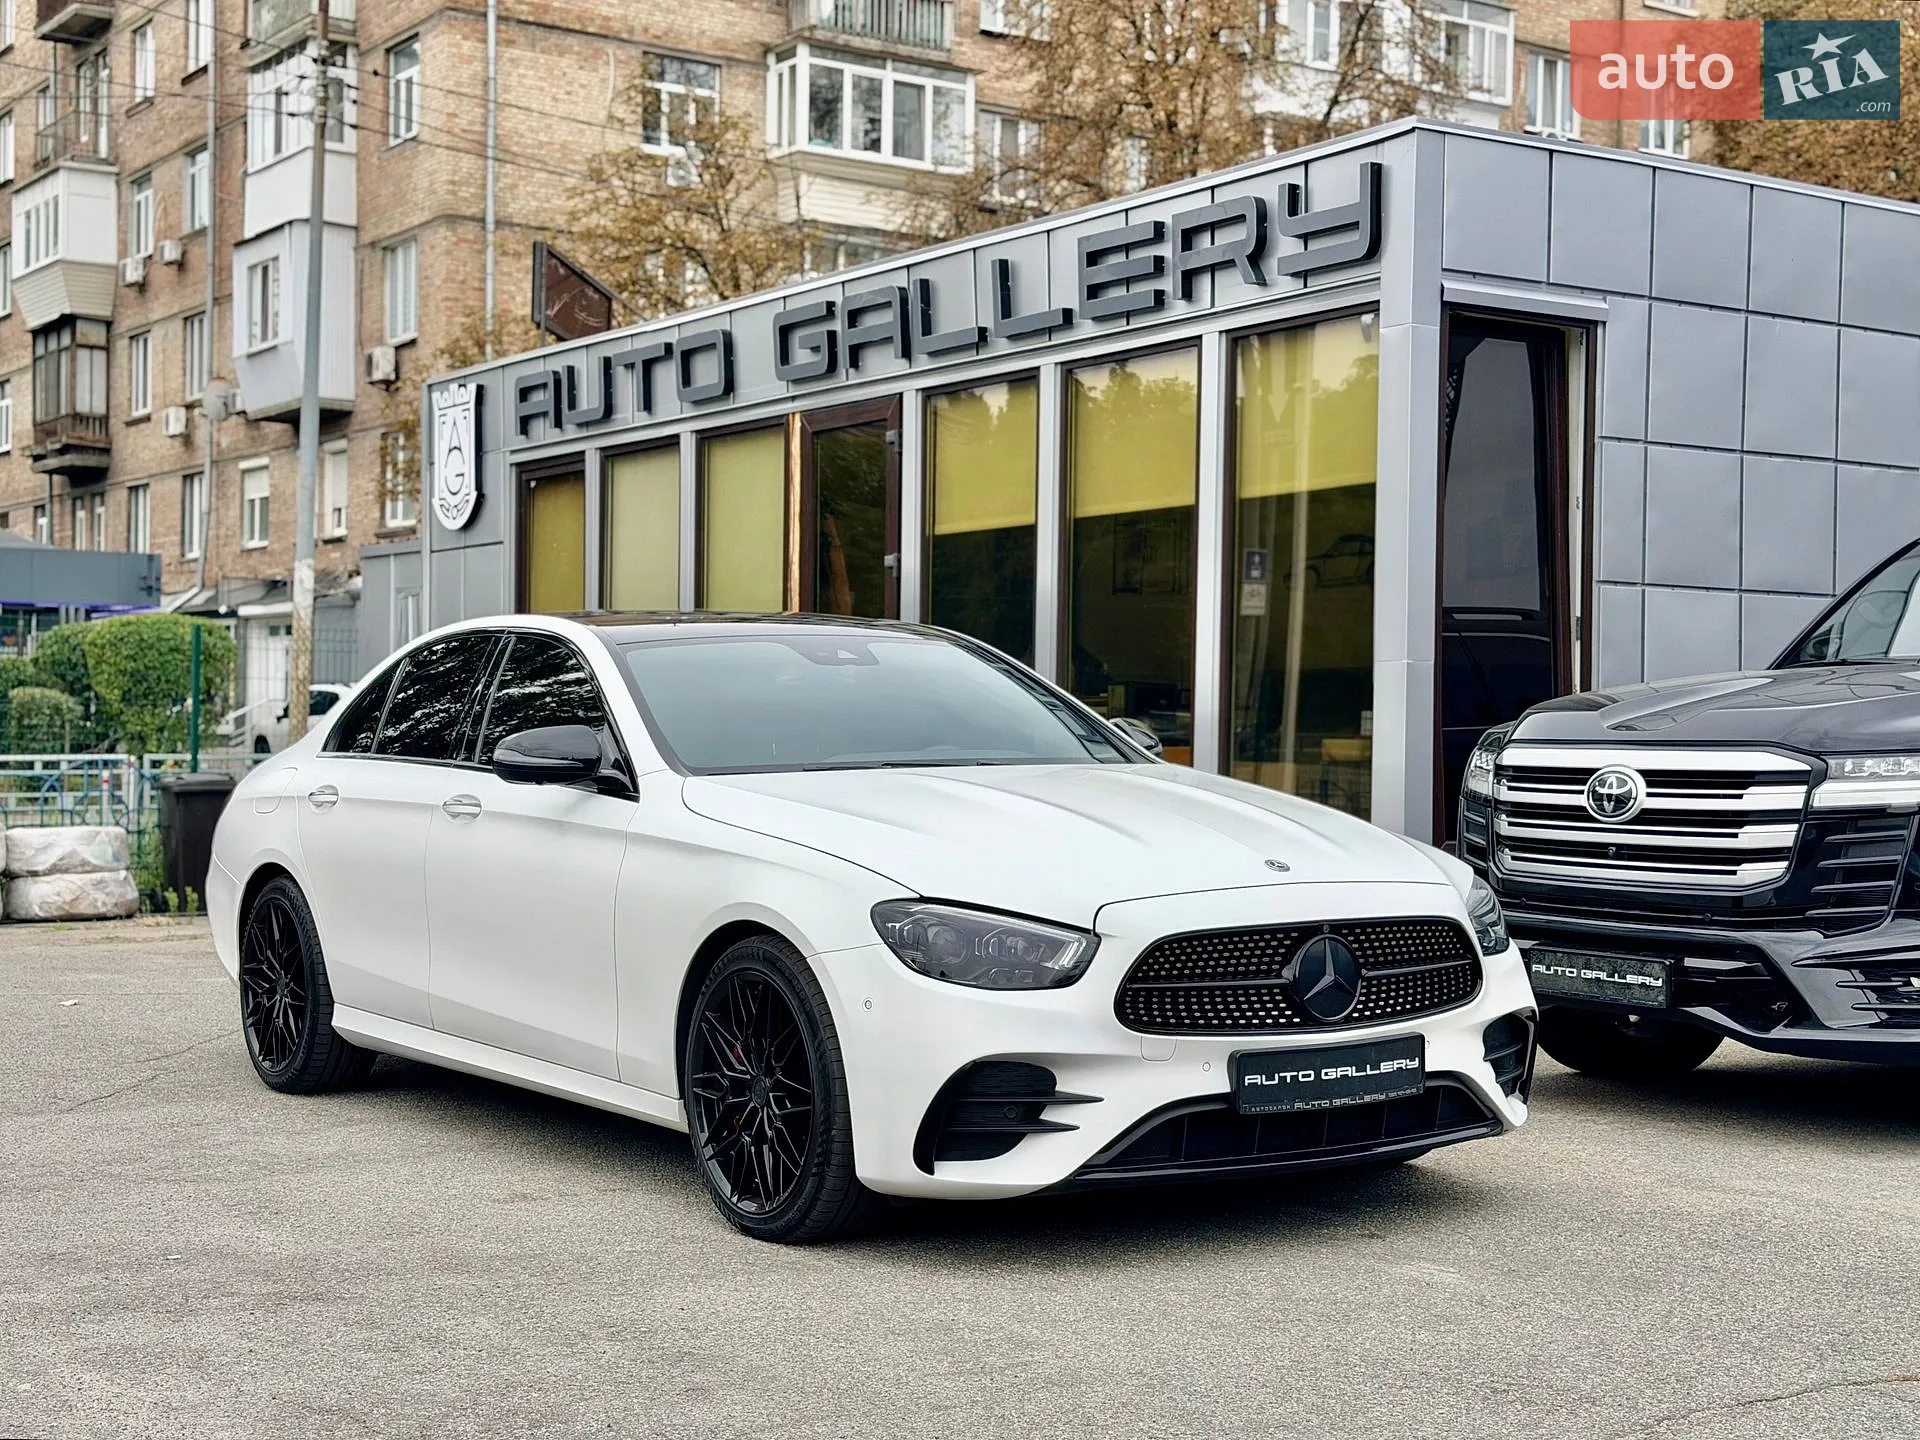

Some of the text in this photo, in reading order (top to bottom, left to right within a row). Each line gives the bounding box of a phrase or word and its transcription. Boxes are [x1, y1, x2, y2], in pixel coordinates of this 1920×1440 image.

[515, 161, 1382, 439] AUTO GALLERY
[1532, 964, 1663, 987] AUTO GALLERY
[1245, 1056, 1419, 1087] AUTO GALLERY
[1294, 1100, 1330, 1110] AUTO
[1332, 1093, 1386, 1106] GALLERY
